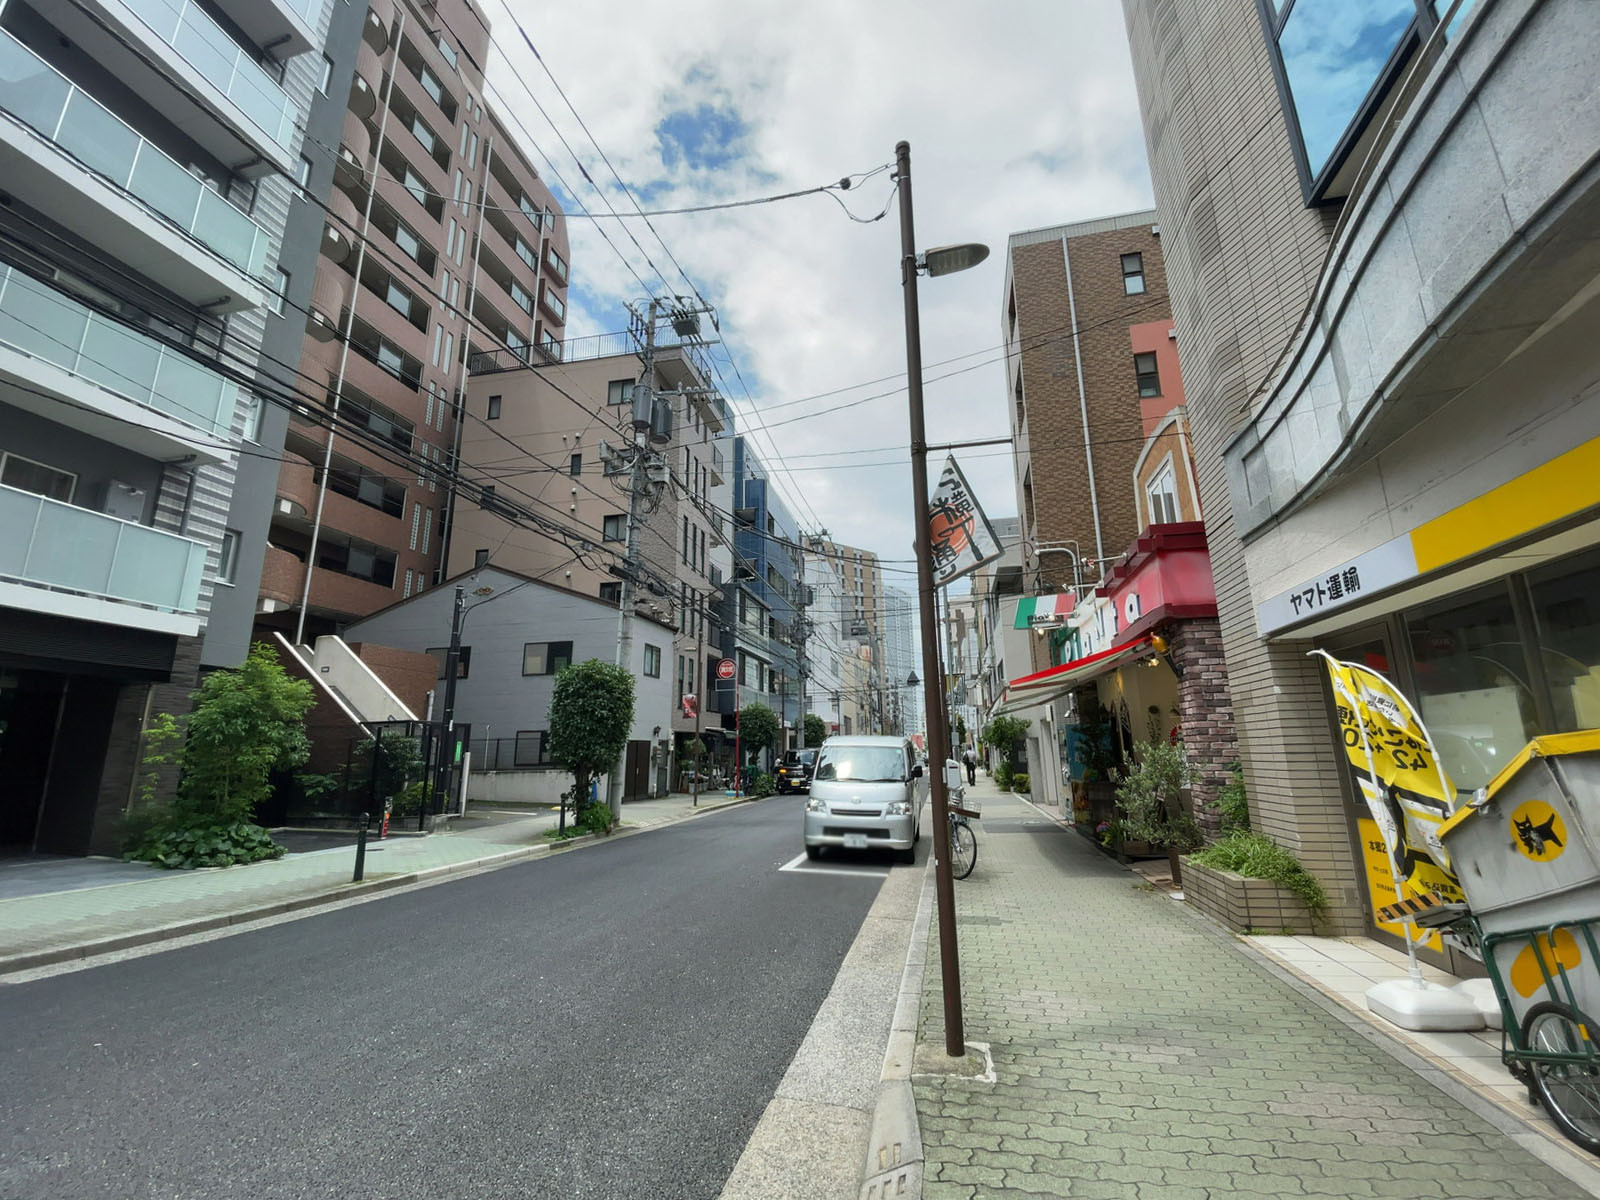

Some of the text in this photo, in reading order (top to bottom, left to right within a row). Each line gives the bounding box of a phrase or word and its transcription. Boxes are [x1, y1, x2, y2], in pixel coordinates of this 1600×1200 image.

[1290, 566, 1361, 615] ヤマト運輸
